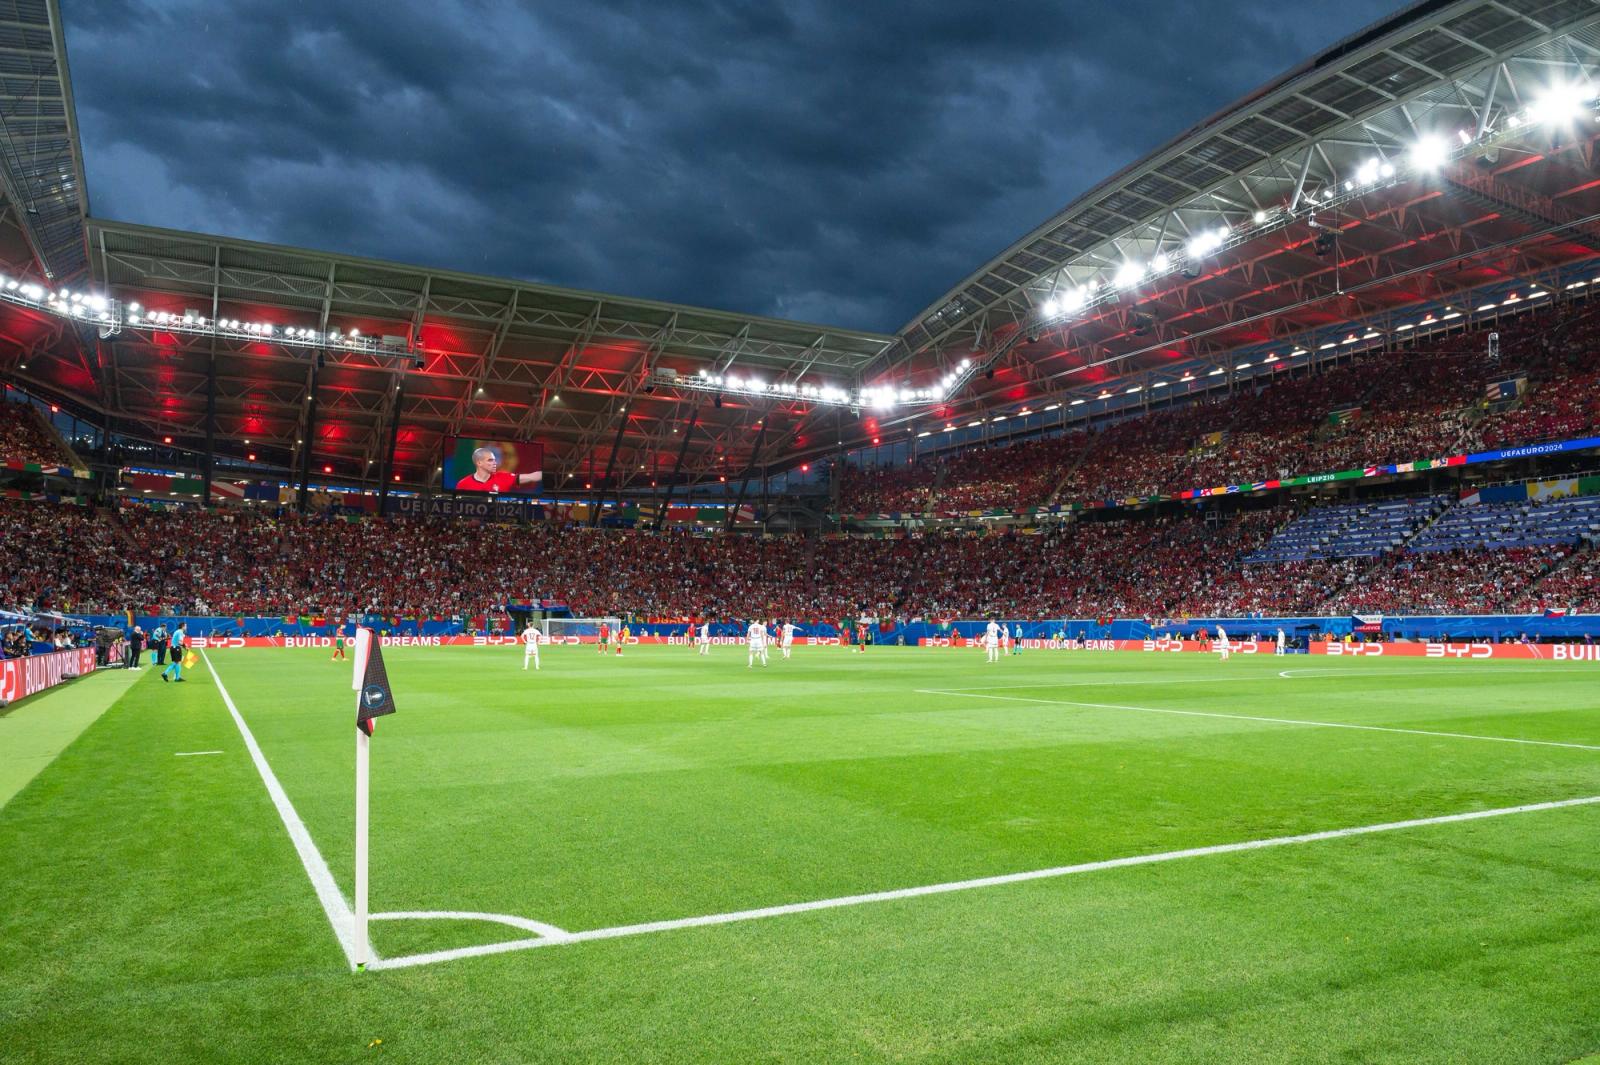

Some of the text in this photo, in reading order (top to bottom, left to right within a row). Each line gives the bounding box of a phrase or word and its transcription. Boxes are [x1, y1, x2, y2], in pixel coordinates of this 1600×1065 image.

[1307, 474, 1335, 483] LEIPZIG
[191, 637, 245, 648] BYD
[285, 636, 331, 648] BUILD
[382, 636, 441, 647] DREAMS
[473, 636, 518, 646] BYD
[807, 637, 841, 646] BYD
[925, 637, 950, 647] BYD
[1020, 639, 1041, 649] UILD
[1072, 640, 1115, 651] DEAMS
[1143, 640, 1183, 652] BYD
[1327, 642, 1384, 656] BYD
[1426, 643, 1493, 658] BYD
[25, 656, 46, 696] BUILD
